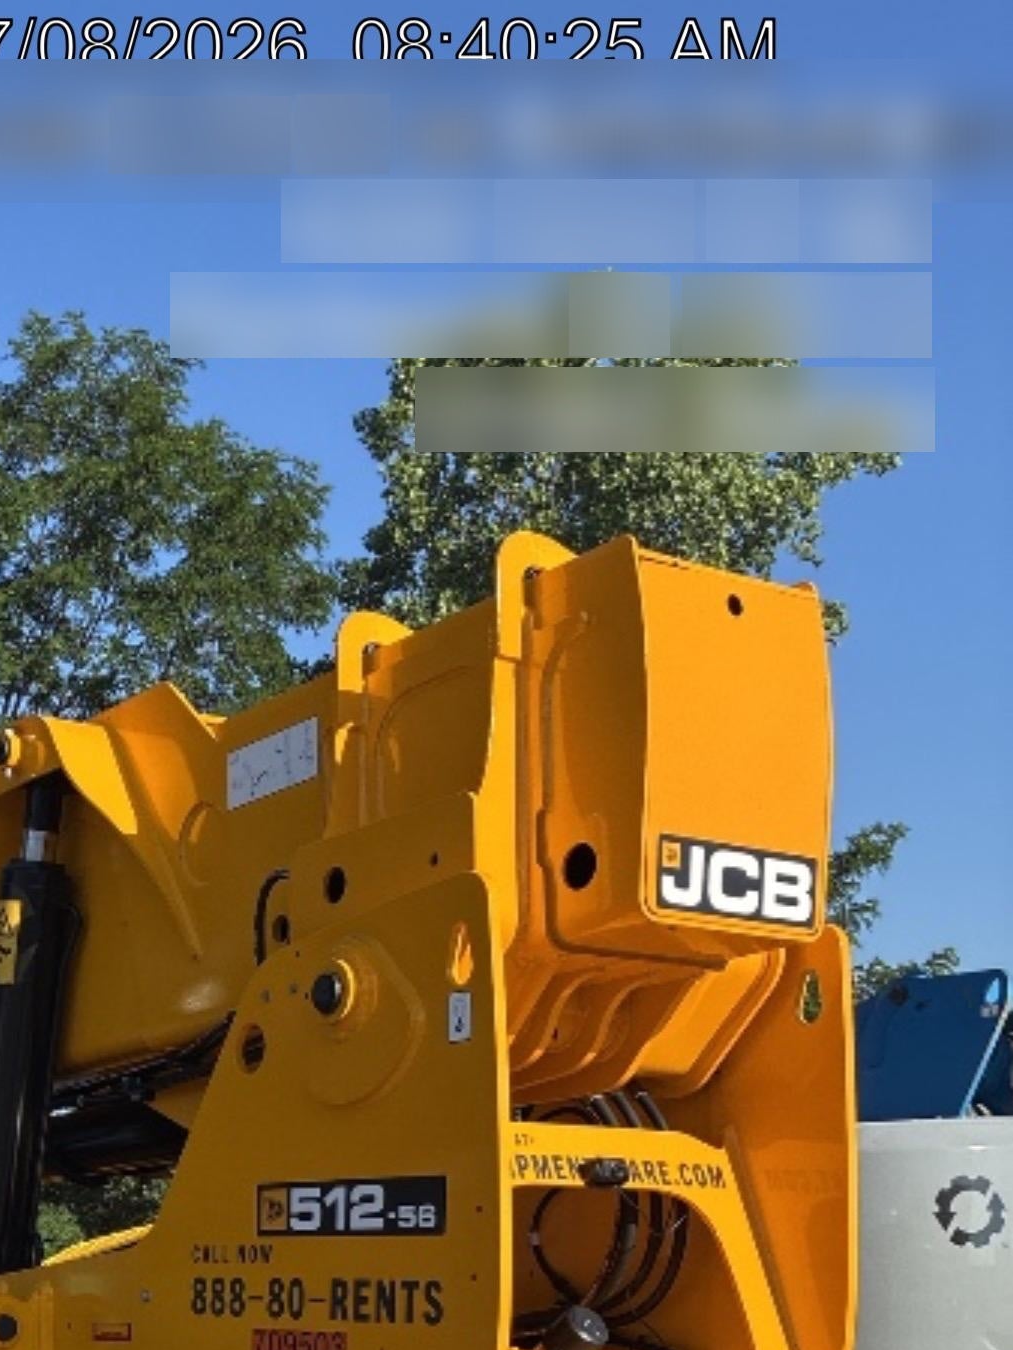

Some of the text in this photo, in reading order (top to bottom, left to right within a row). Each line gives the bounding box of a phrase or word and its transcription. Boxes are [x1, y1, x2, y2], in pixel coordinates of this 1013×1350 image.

[660, 845, 813, 922] JCB
[192, 1244, 272, 1263] CALL NOW
[191, 1276, 444, 1325] 888-80-RENTS
